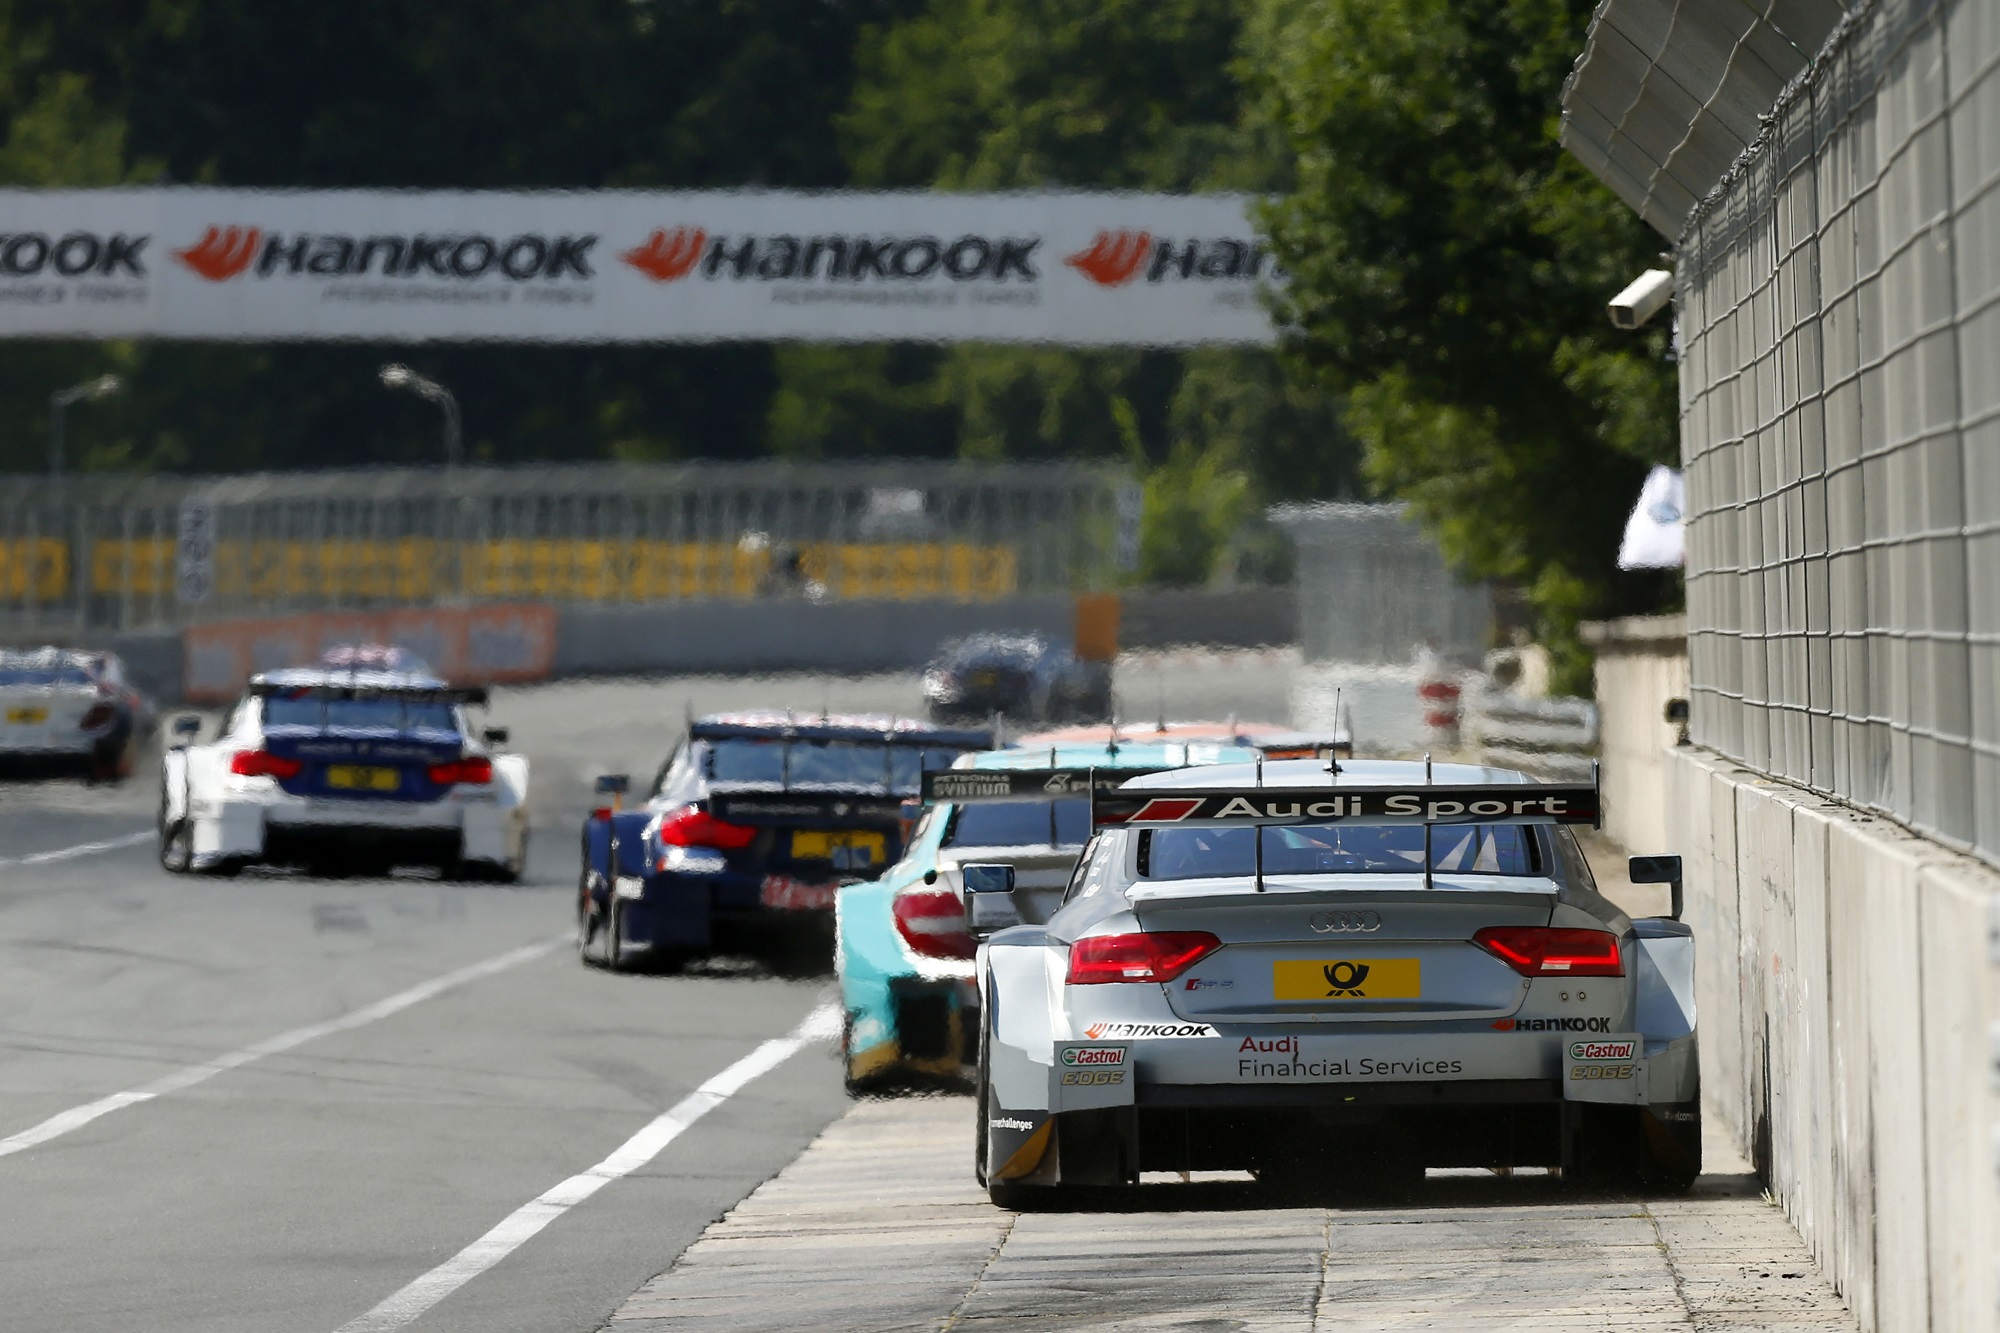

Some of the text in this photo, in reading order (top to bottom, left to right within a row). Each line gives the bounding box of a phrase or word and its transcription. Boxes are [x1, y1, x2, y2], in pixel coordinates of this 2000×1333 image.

[1213, 796, 1567, 819] Audi Sport
[1238, 1036, 1299, 1053] Audi
[1585, 1043, 1631, 1058] Castrol
[1077, 1050, 1123, 1064] Castrol
[1238, 1058, 1462, 1077] Financial Services
[1570, 1065, 1636, 1080] EDGE
[1061, 1071, 1126, 1085] EDGE
